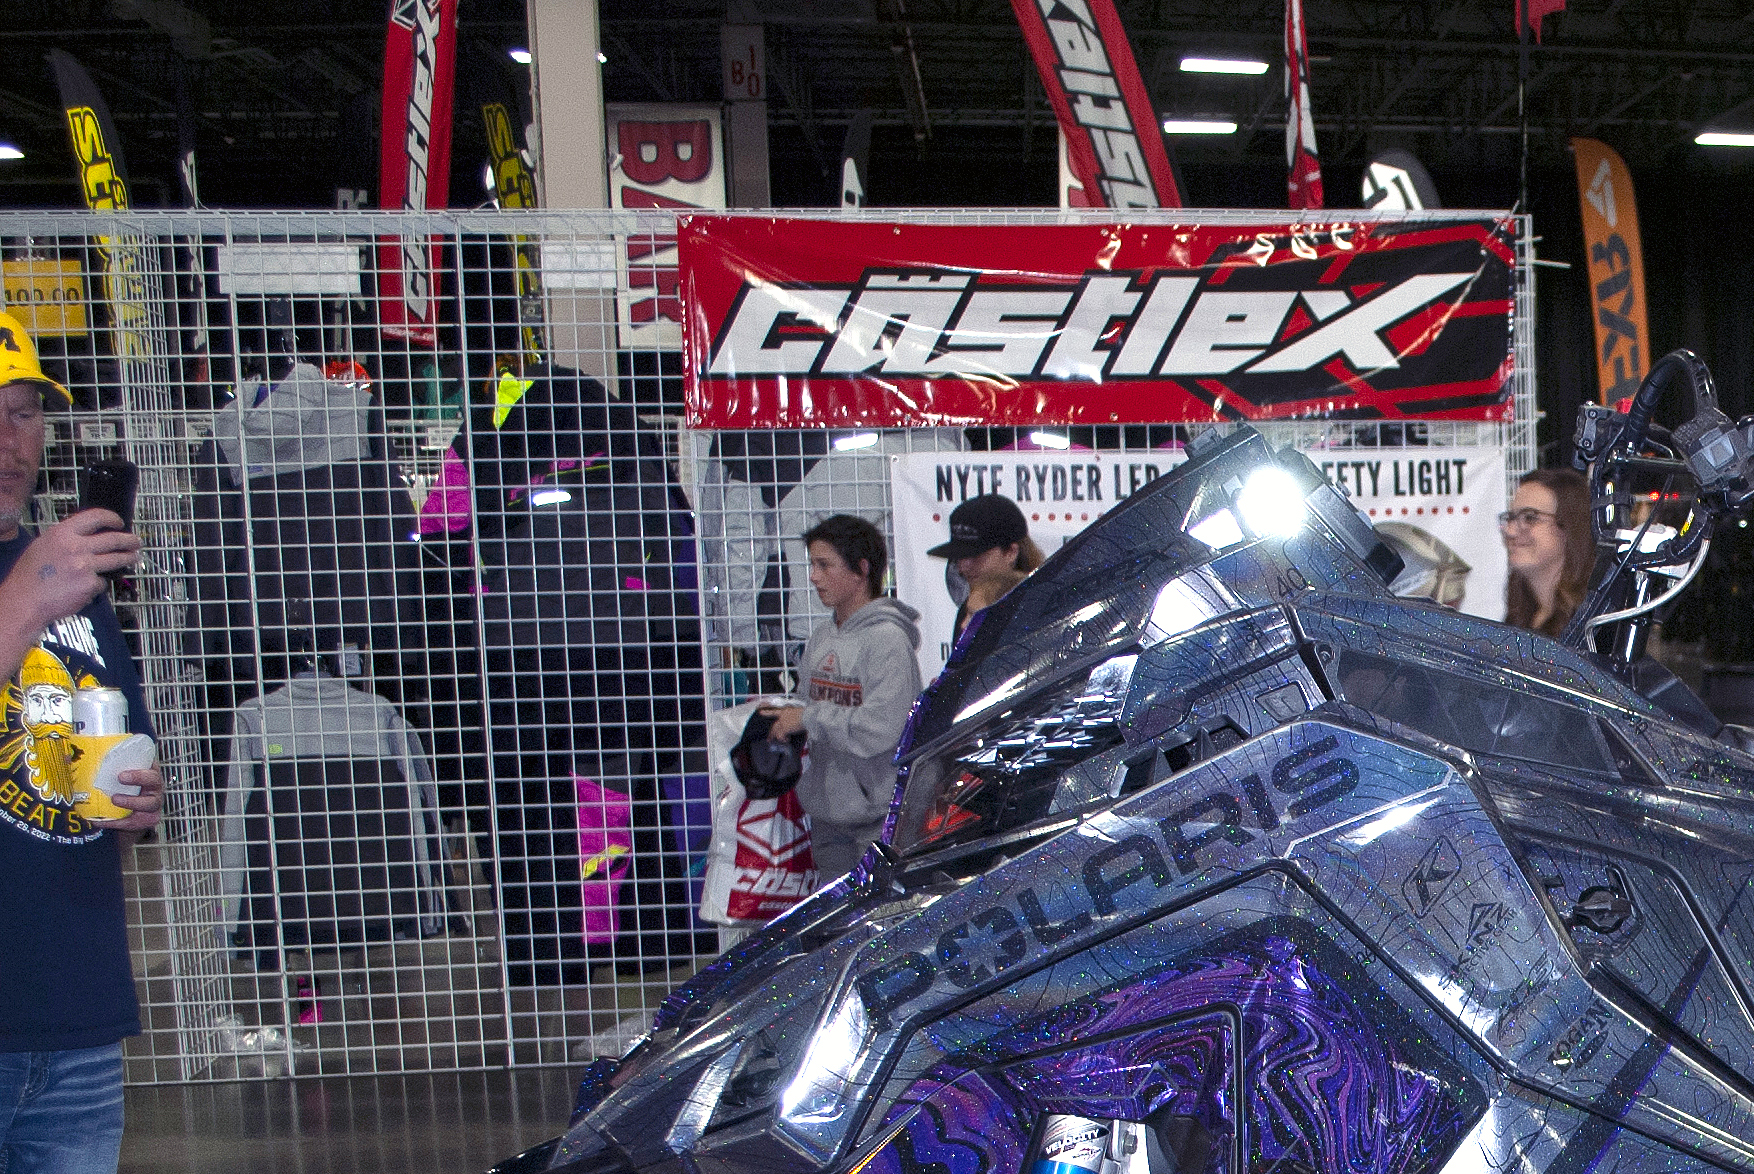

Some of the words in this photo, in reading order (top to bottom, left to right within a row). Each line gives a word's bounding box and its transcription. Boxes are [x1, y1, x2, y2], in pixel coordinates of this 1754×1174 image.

[936, 464, 1003, 500] NYTE
[1015, 462, 1101, 508] RYDER
[1393, 459, 1468, 497] LIGHT
[857, 735, 1360, 1031] POLARIS
